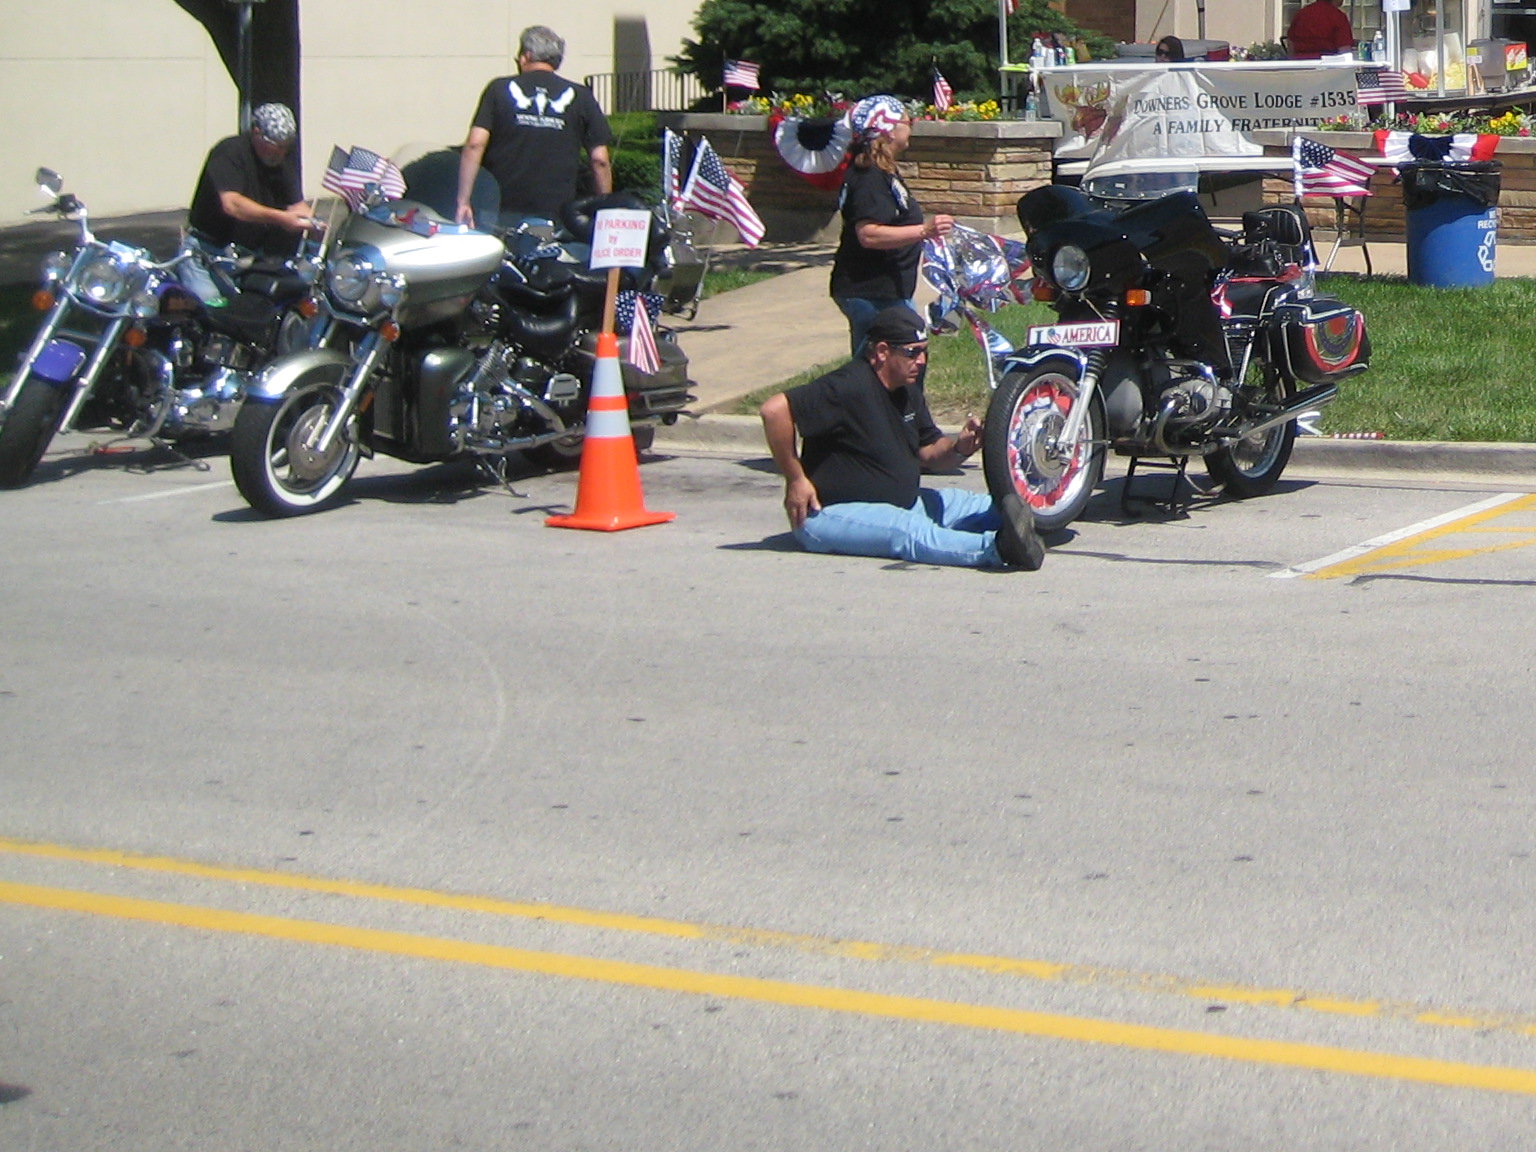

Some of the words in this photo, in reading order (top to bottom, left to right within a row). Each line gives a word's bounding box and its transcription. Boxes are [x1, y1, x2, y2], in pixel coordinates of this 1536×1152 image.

[1133, 96, 1190, 115] DOWNERS
[1197, 92, 1248, 109] GROVE
[1254, 91, 1303, 109] LODGE
[1309, 90, 1357, 108] #1535
[1152, 123, 1163, 136] A
[1167, 118, 1224, 135] FAMILY
[604, 219, 647, 231] PARKING
[613, 247, 642, 258] ORDER
[1035, 329, 1044, 345] I
[1062, 326, 1112, 343] AMERICA
